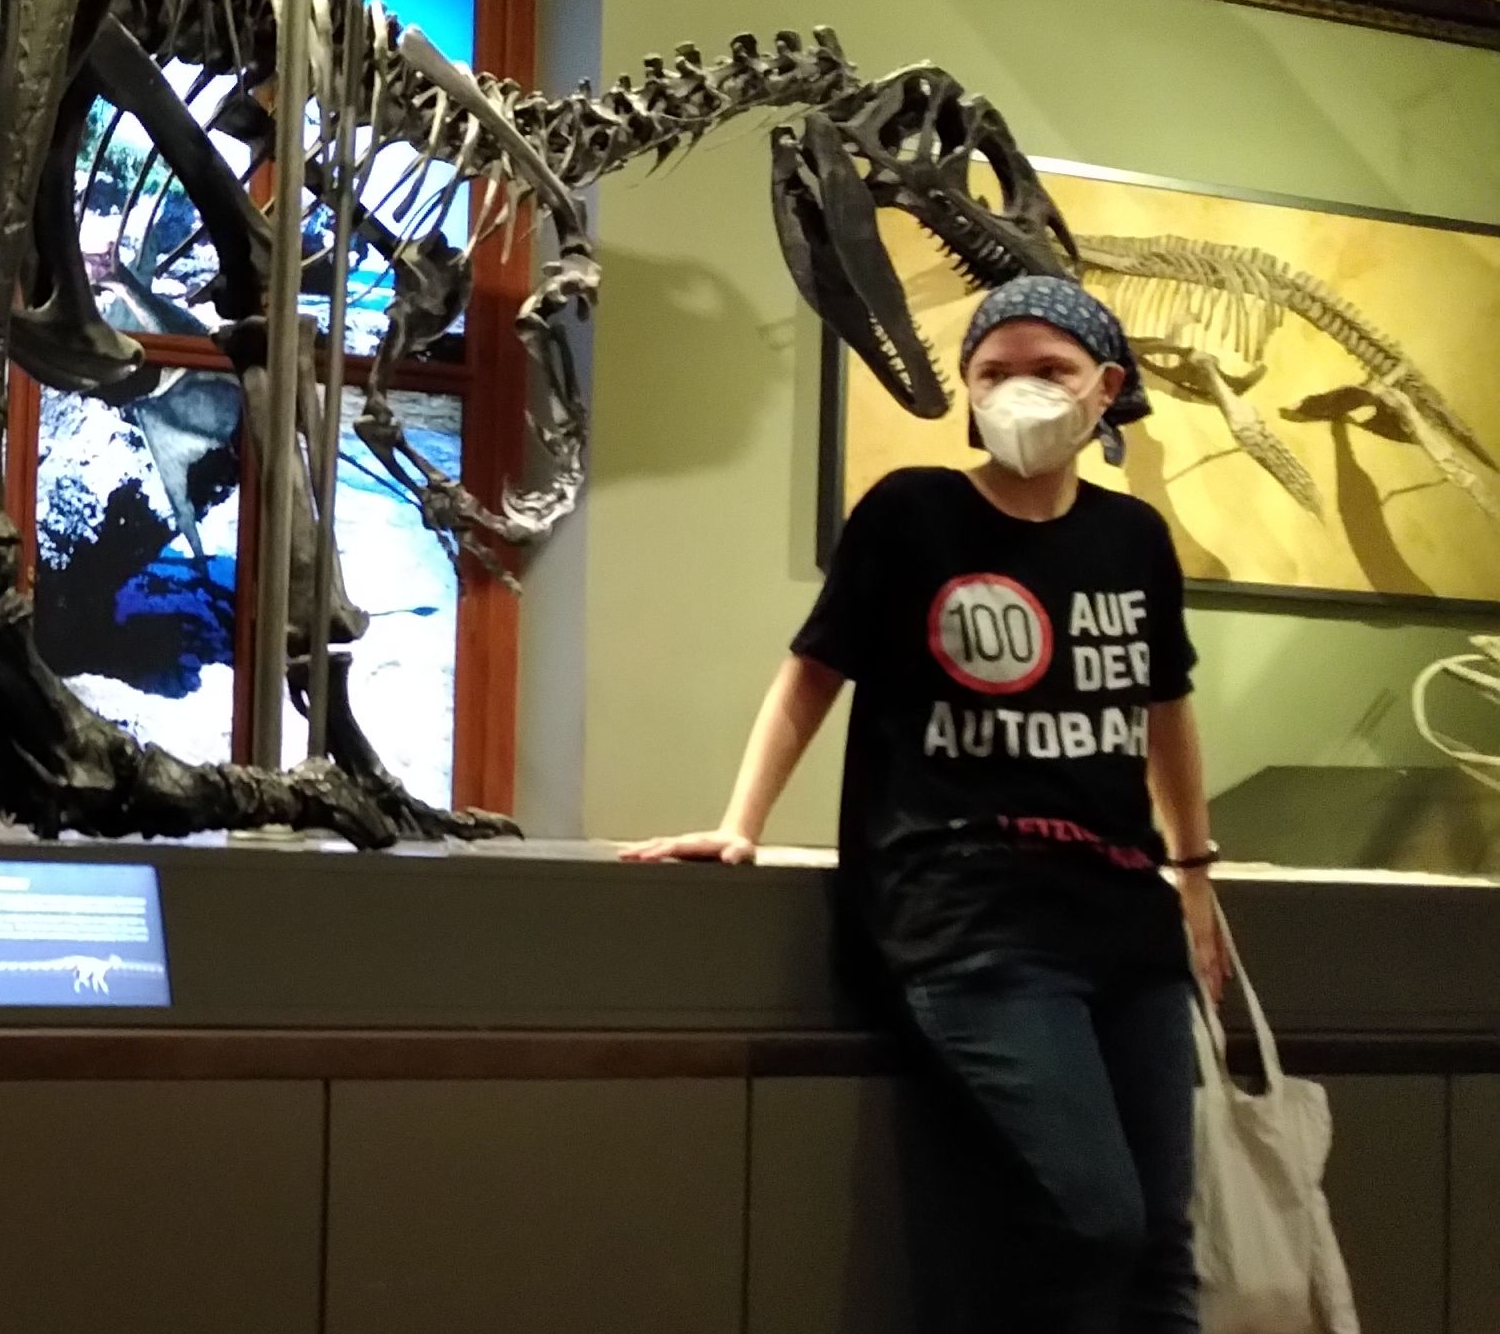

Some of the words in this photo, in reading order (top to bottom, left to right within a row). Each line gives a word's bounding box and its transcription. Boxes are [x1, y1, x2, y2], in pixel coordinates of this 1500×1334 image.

[948, 603, 1034, 664] 100
[1069, 590, 1147, 637] AUF
[1073, 641, 1150, 692] DER
